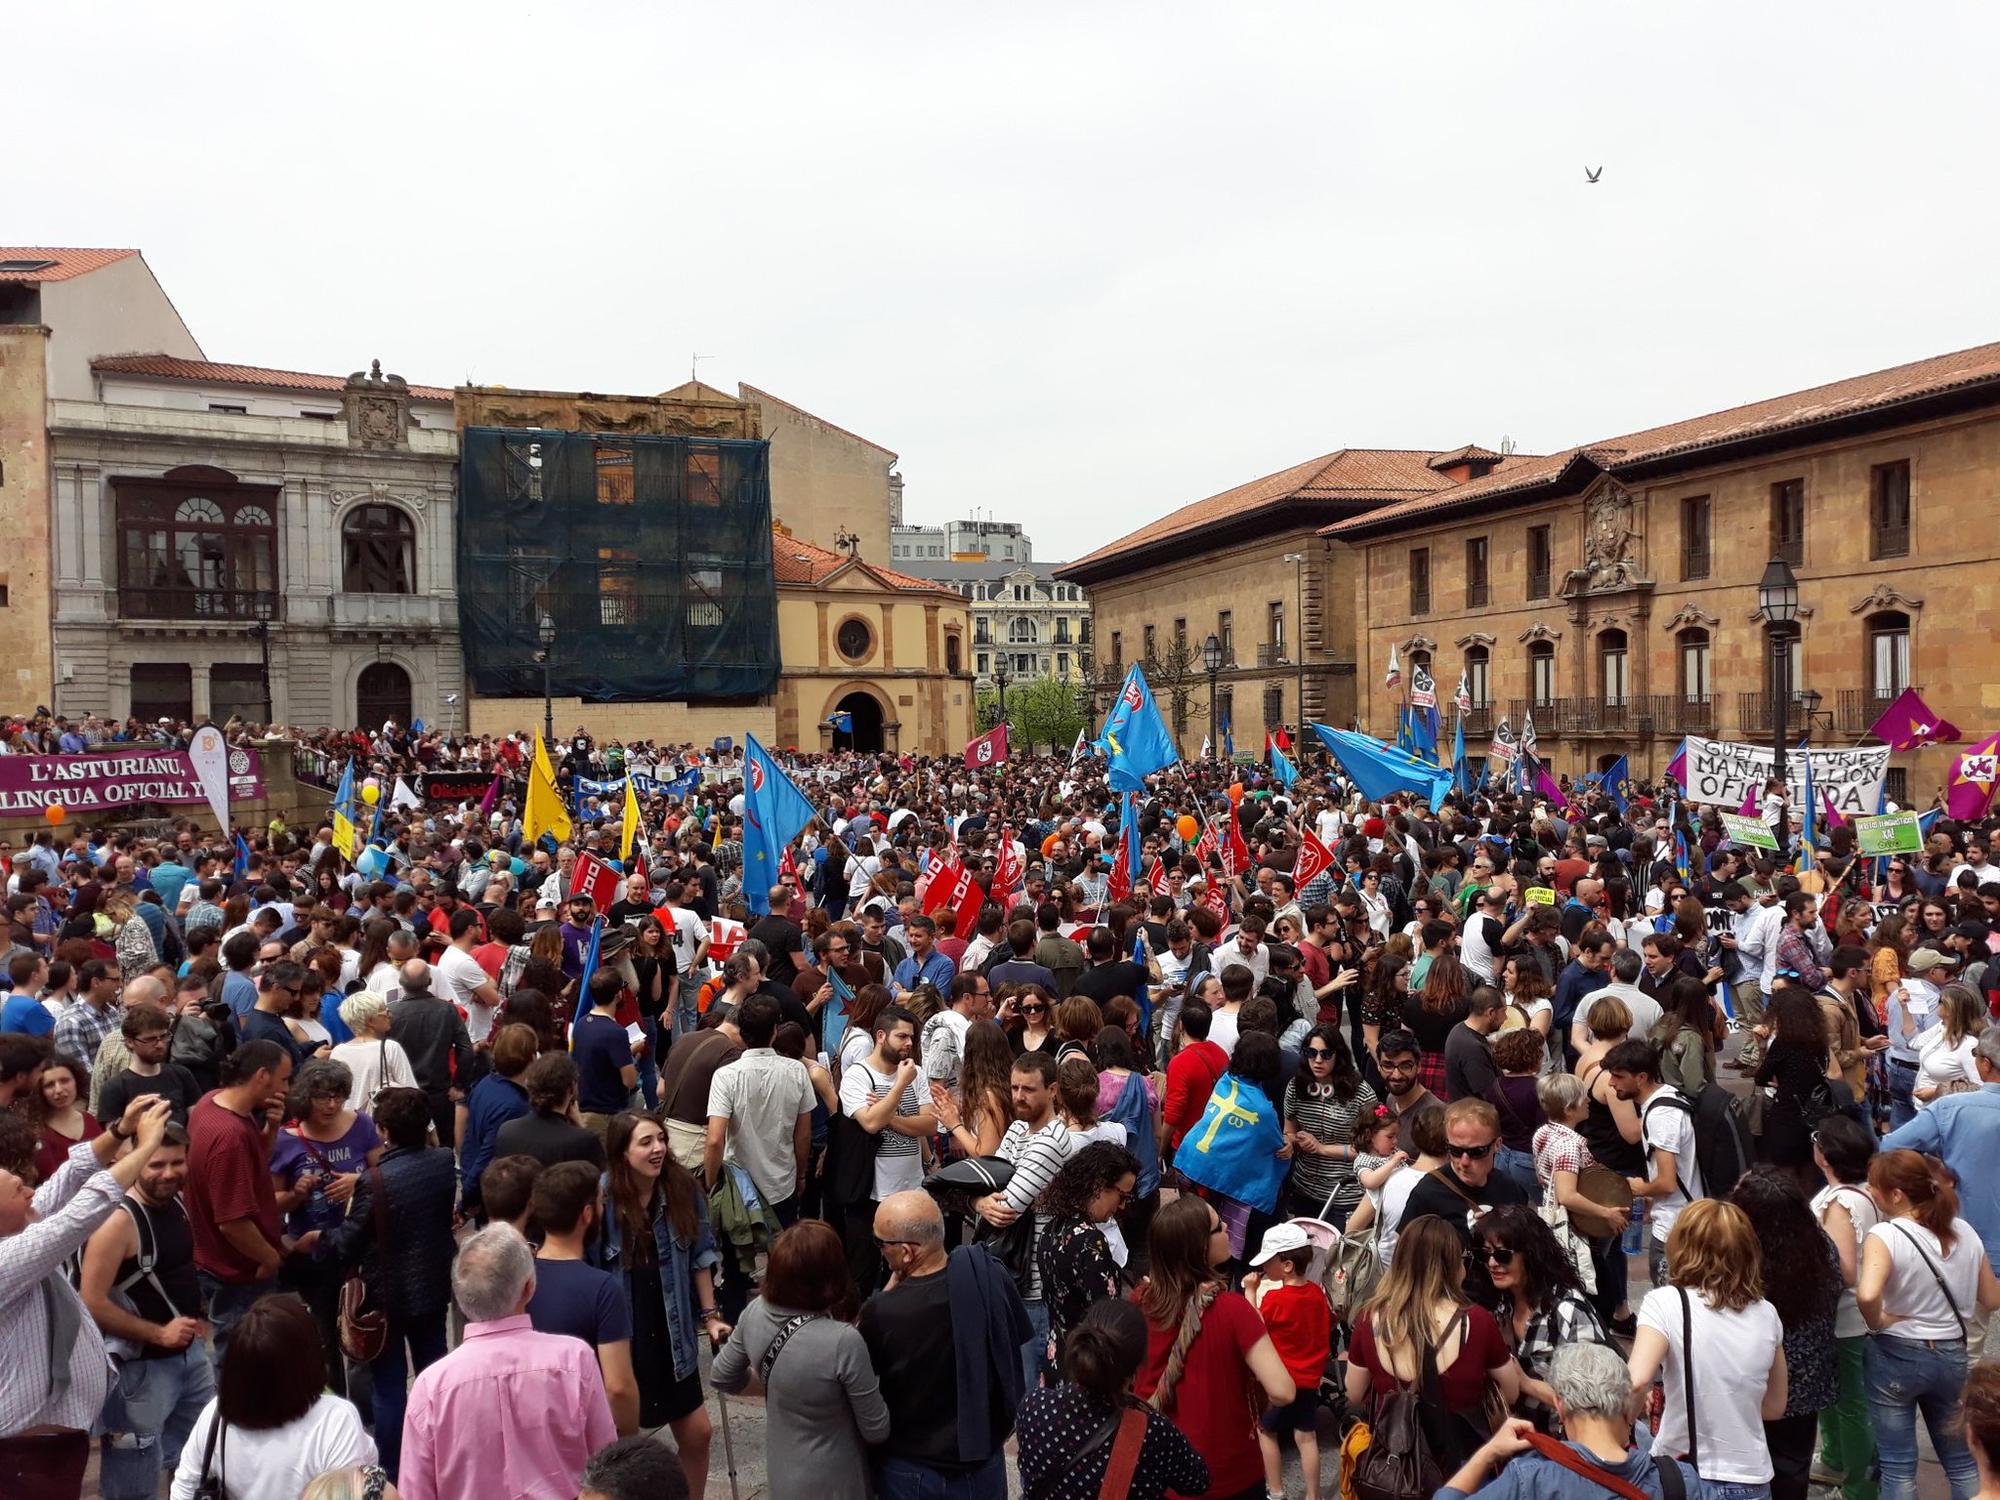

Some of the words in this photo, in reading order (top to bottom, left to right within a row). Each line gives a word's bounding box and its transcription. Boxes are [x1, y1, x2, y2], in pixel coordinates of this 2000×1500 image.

[104, 781, 190, 802] OFICIAL
[190, 781, 208, 798] Y
[328, 1147, 351, 1163] UNA
